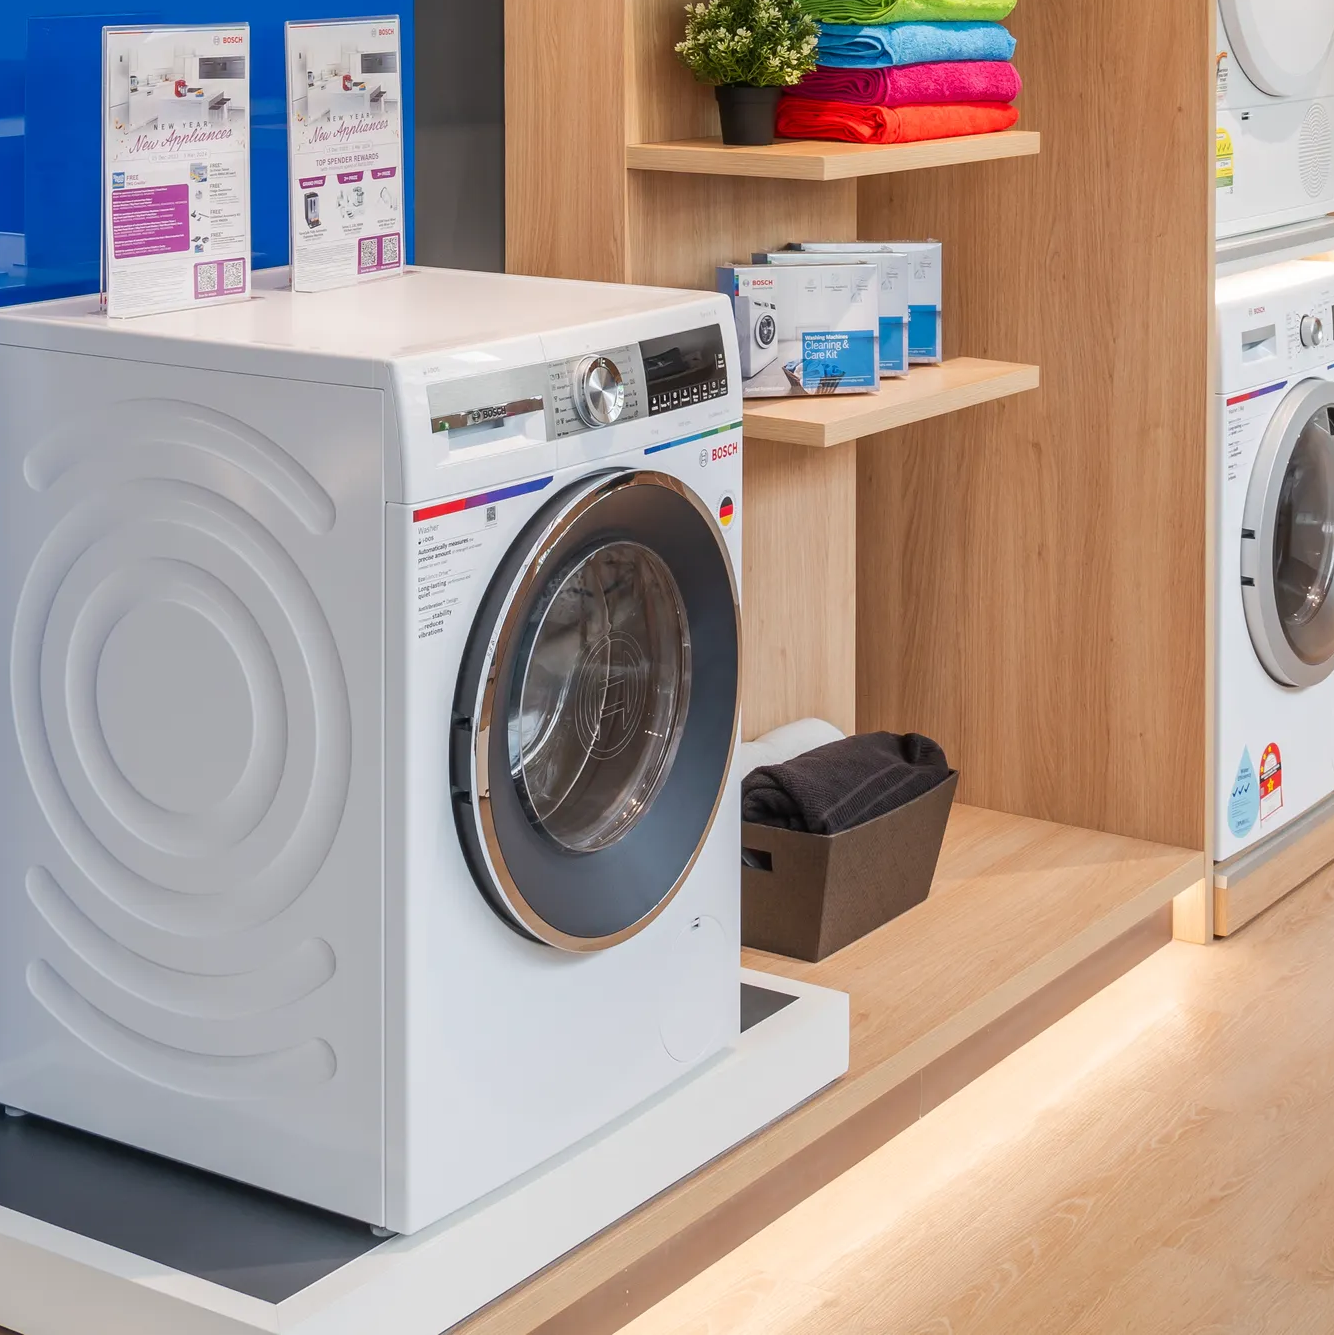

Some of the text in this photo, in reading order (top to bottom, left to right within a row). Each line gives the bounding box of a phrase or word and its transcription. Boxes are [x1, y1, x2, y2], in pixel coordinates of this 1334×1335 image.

[378, 28, 395, 36] BOSCH
[222, 36, 243, 44] BOSCH
[153, 123, 175, 131] NEW
[308, 119, 389, 144] New Appliances
[129, 127, 234, 154] New Appliances
[315, 153, 379, 167] TOP SPENDER REWARDS
[804, 339, 850, 350] Cleaning &
[804, 349, 838, 360] Care Kit
[482, 405, 507, 419] BOSCH
[711, 441, 738, 461] BOSCH
[417, 524, 439, 535] Washer
[418, 543, 448, 556] Automatically
[448, 537, 469, 548] measures
[417, 553, 435, 564] precise
[435, 549, 452, 559] amount
[418, 580, 447, 593] Long-lasting
[417, 591, 431, 600] quiet
[431, 609, 452, 620] stability
[423, 619, 444, 630] reduces
[417, 627, 443, 639] vibrations
